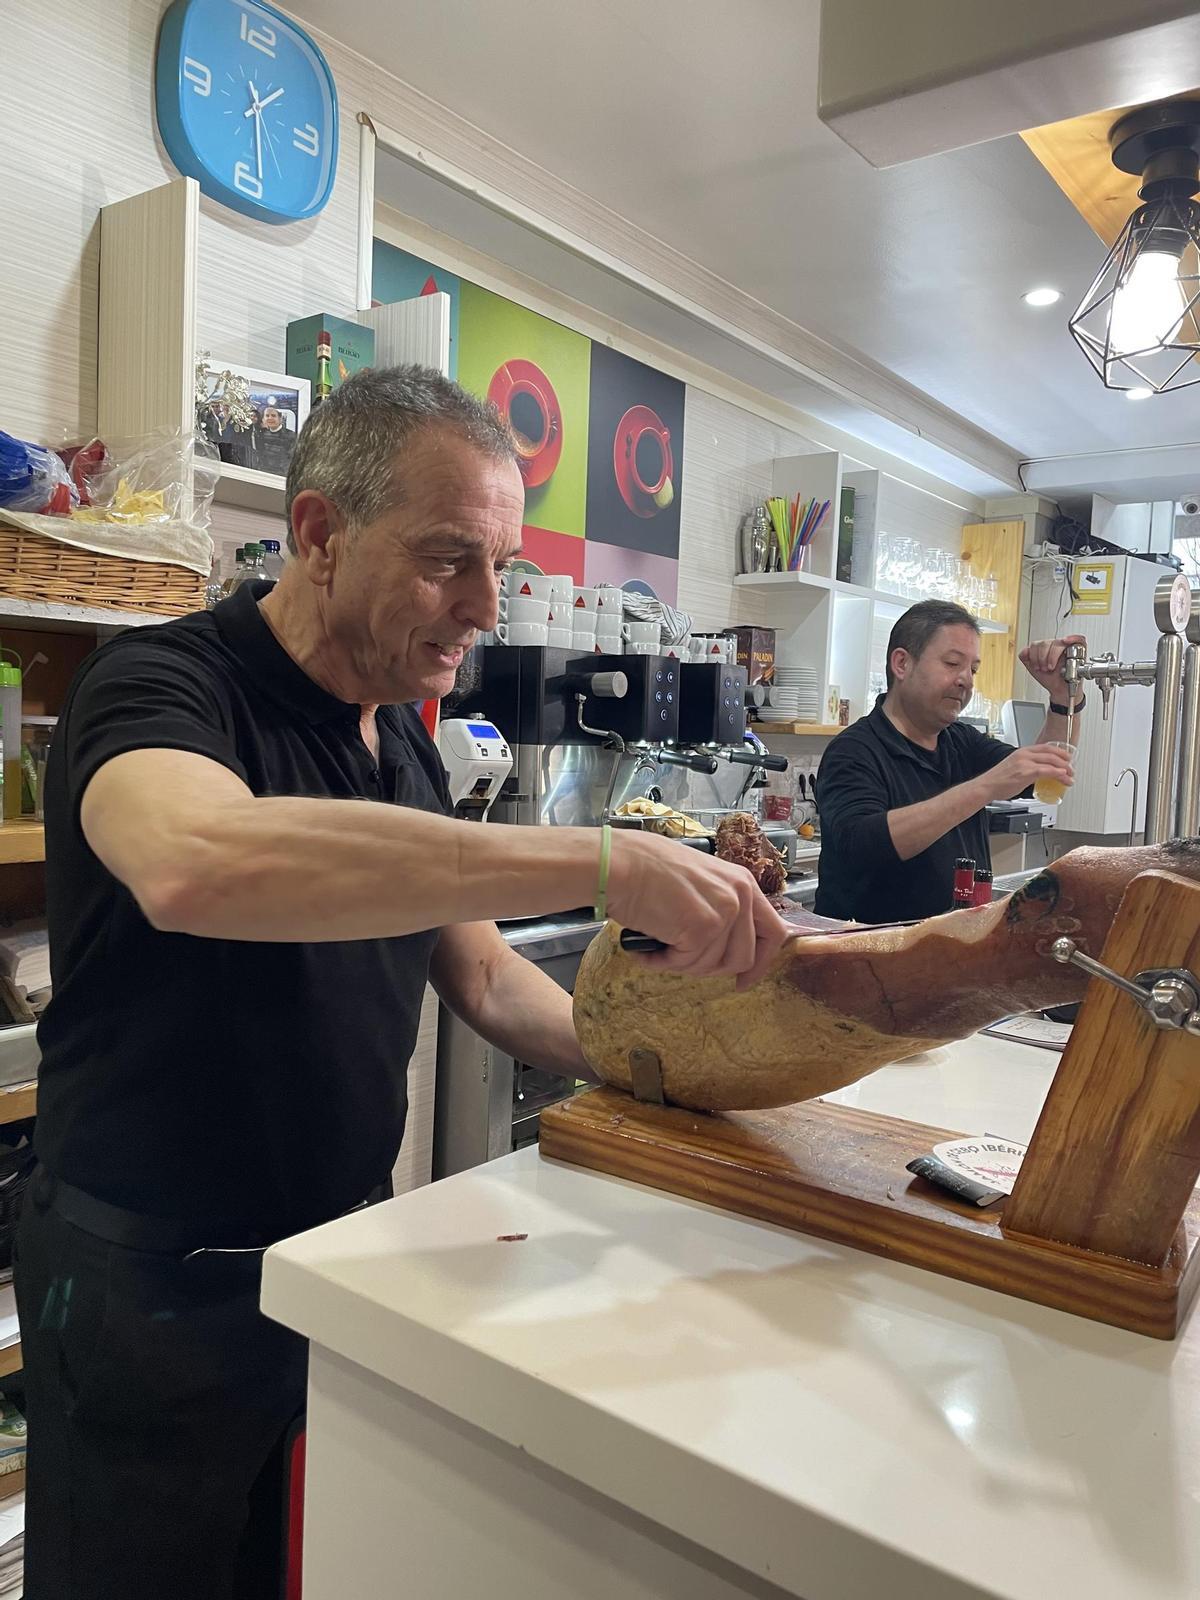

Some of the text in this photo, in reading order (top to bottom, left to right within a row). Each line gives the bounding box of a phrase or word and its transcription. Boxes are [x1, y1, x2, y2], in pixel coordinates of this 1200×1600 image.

[240, 13, 277, 59] 12
[184, 56, 212, 97] 9
[293, 123, 320, 157] 3
[234, 161, 263, 200] 6
[981, 1144, 1025, 1158] IBÉRI
